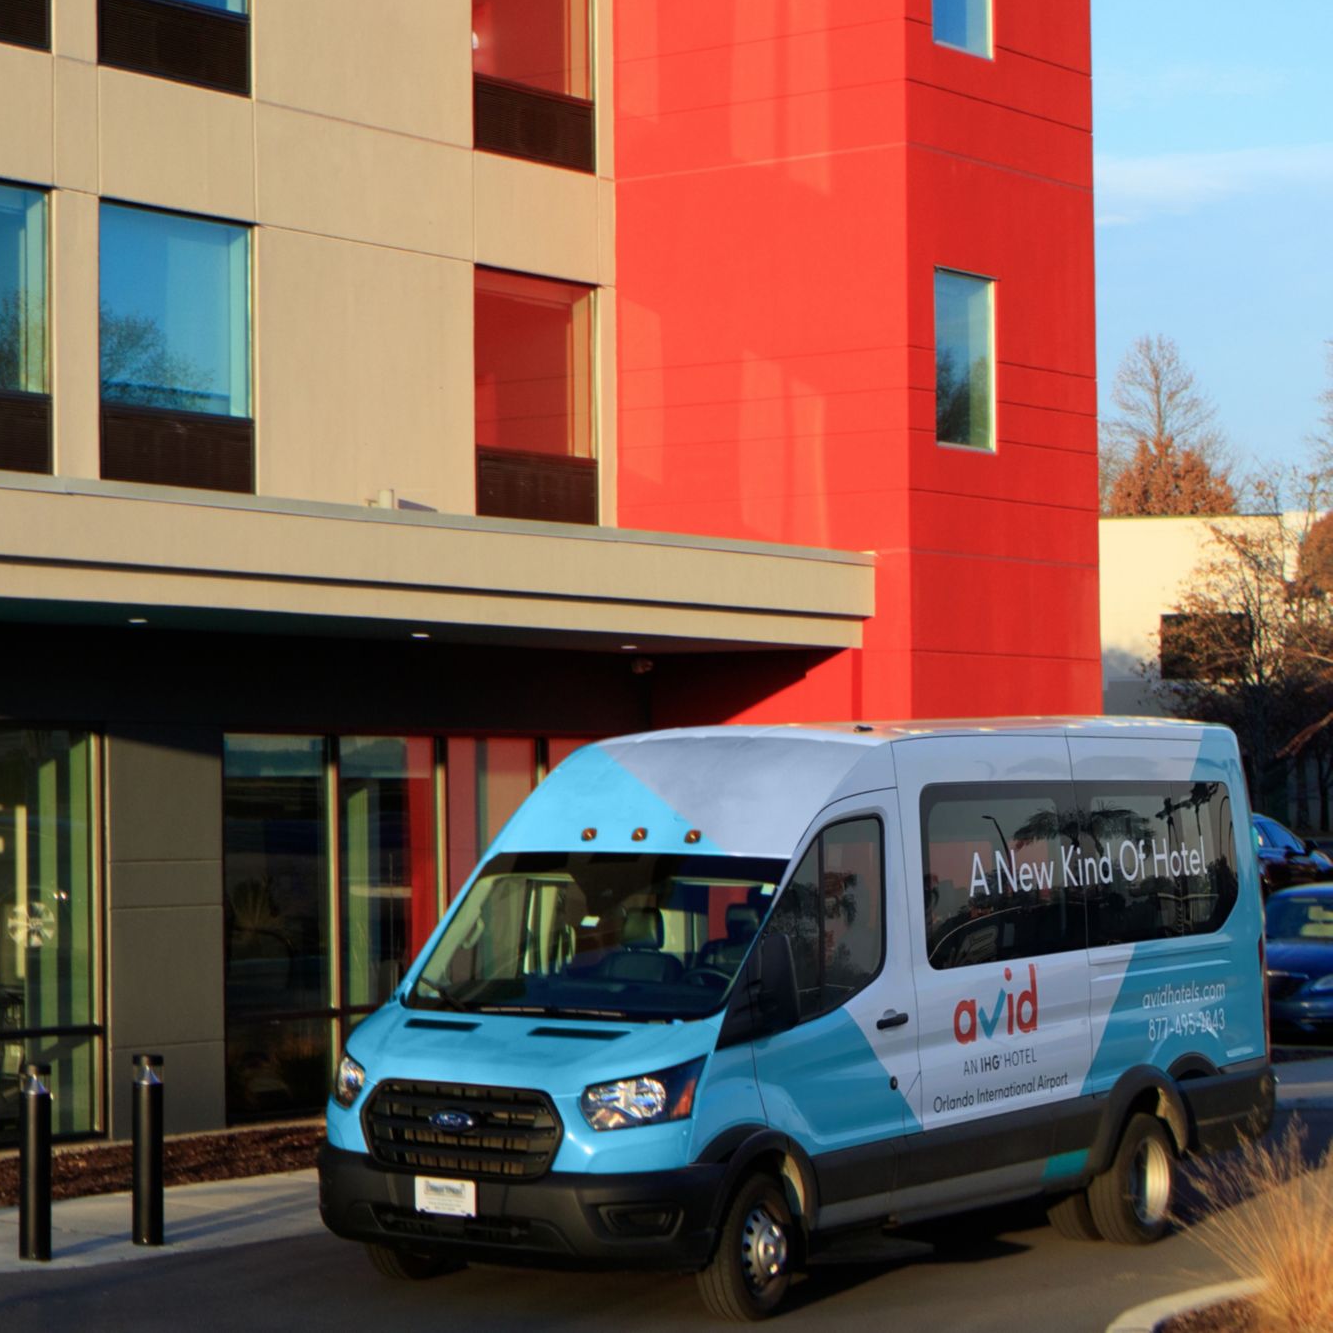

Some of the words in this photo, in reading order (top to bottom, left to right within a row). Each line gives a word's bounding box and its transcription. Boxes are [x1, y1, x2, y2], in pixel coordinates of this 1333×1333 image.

[969, 851, 990, 897] A
[995, 849, 1054, 896] New
[1060, 842, 1112, 888] Kind
[1119, 839, 1147, 881] Of
[1151, 835, 1208, 879] Hotel
[954, 963, 1038, 1045] avid
[1142, 980, 1225, 1009] avidhotels.com
[1148, 1008, 1225, 1041] 877-495-2843
[963, 1059, 978, 1076] AN
[1004, 1048, 1037, 1068] HOTEL
[933, 1091, 974, 1113] Orlando
[977, 1076, 1036, 1104] International
[1037, 1072, 1068, 1094] Airport
